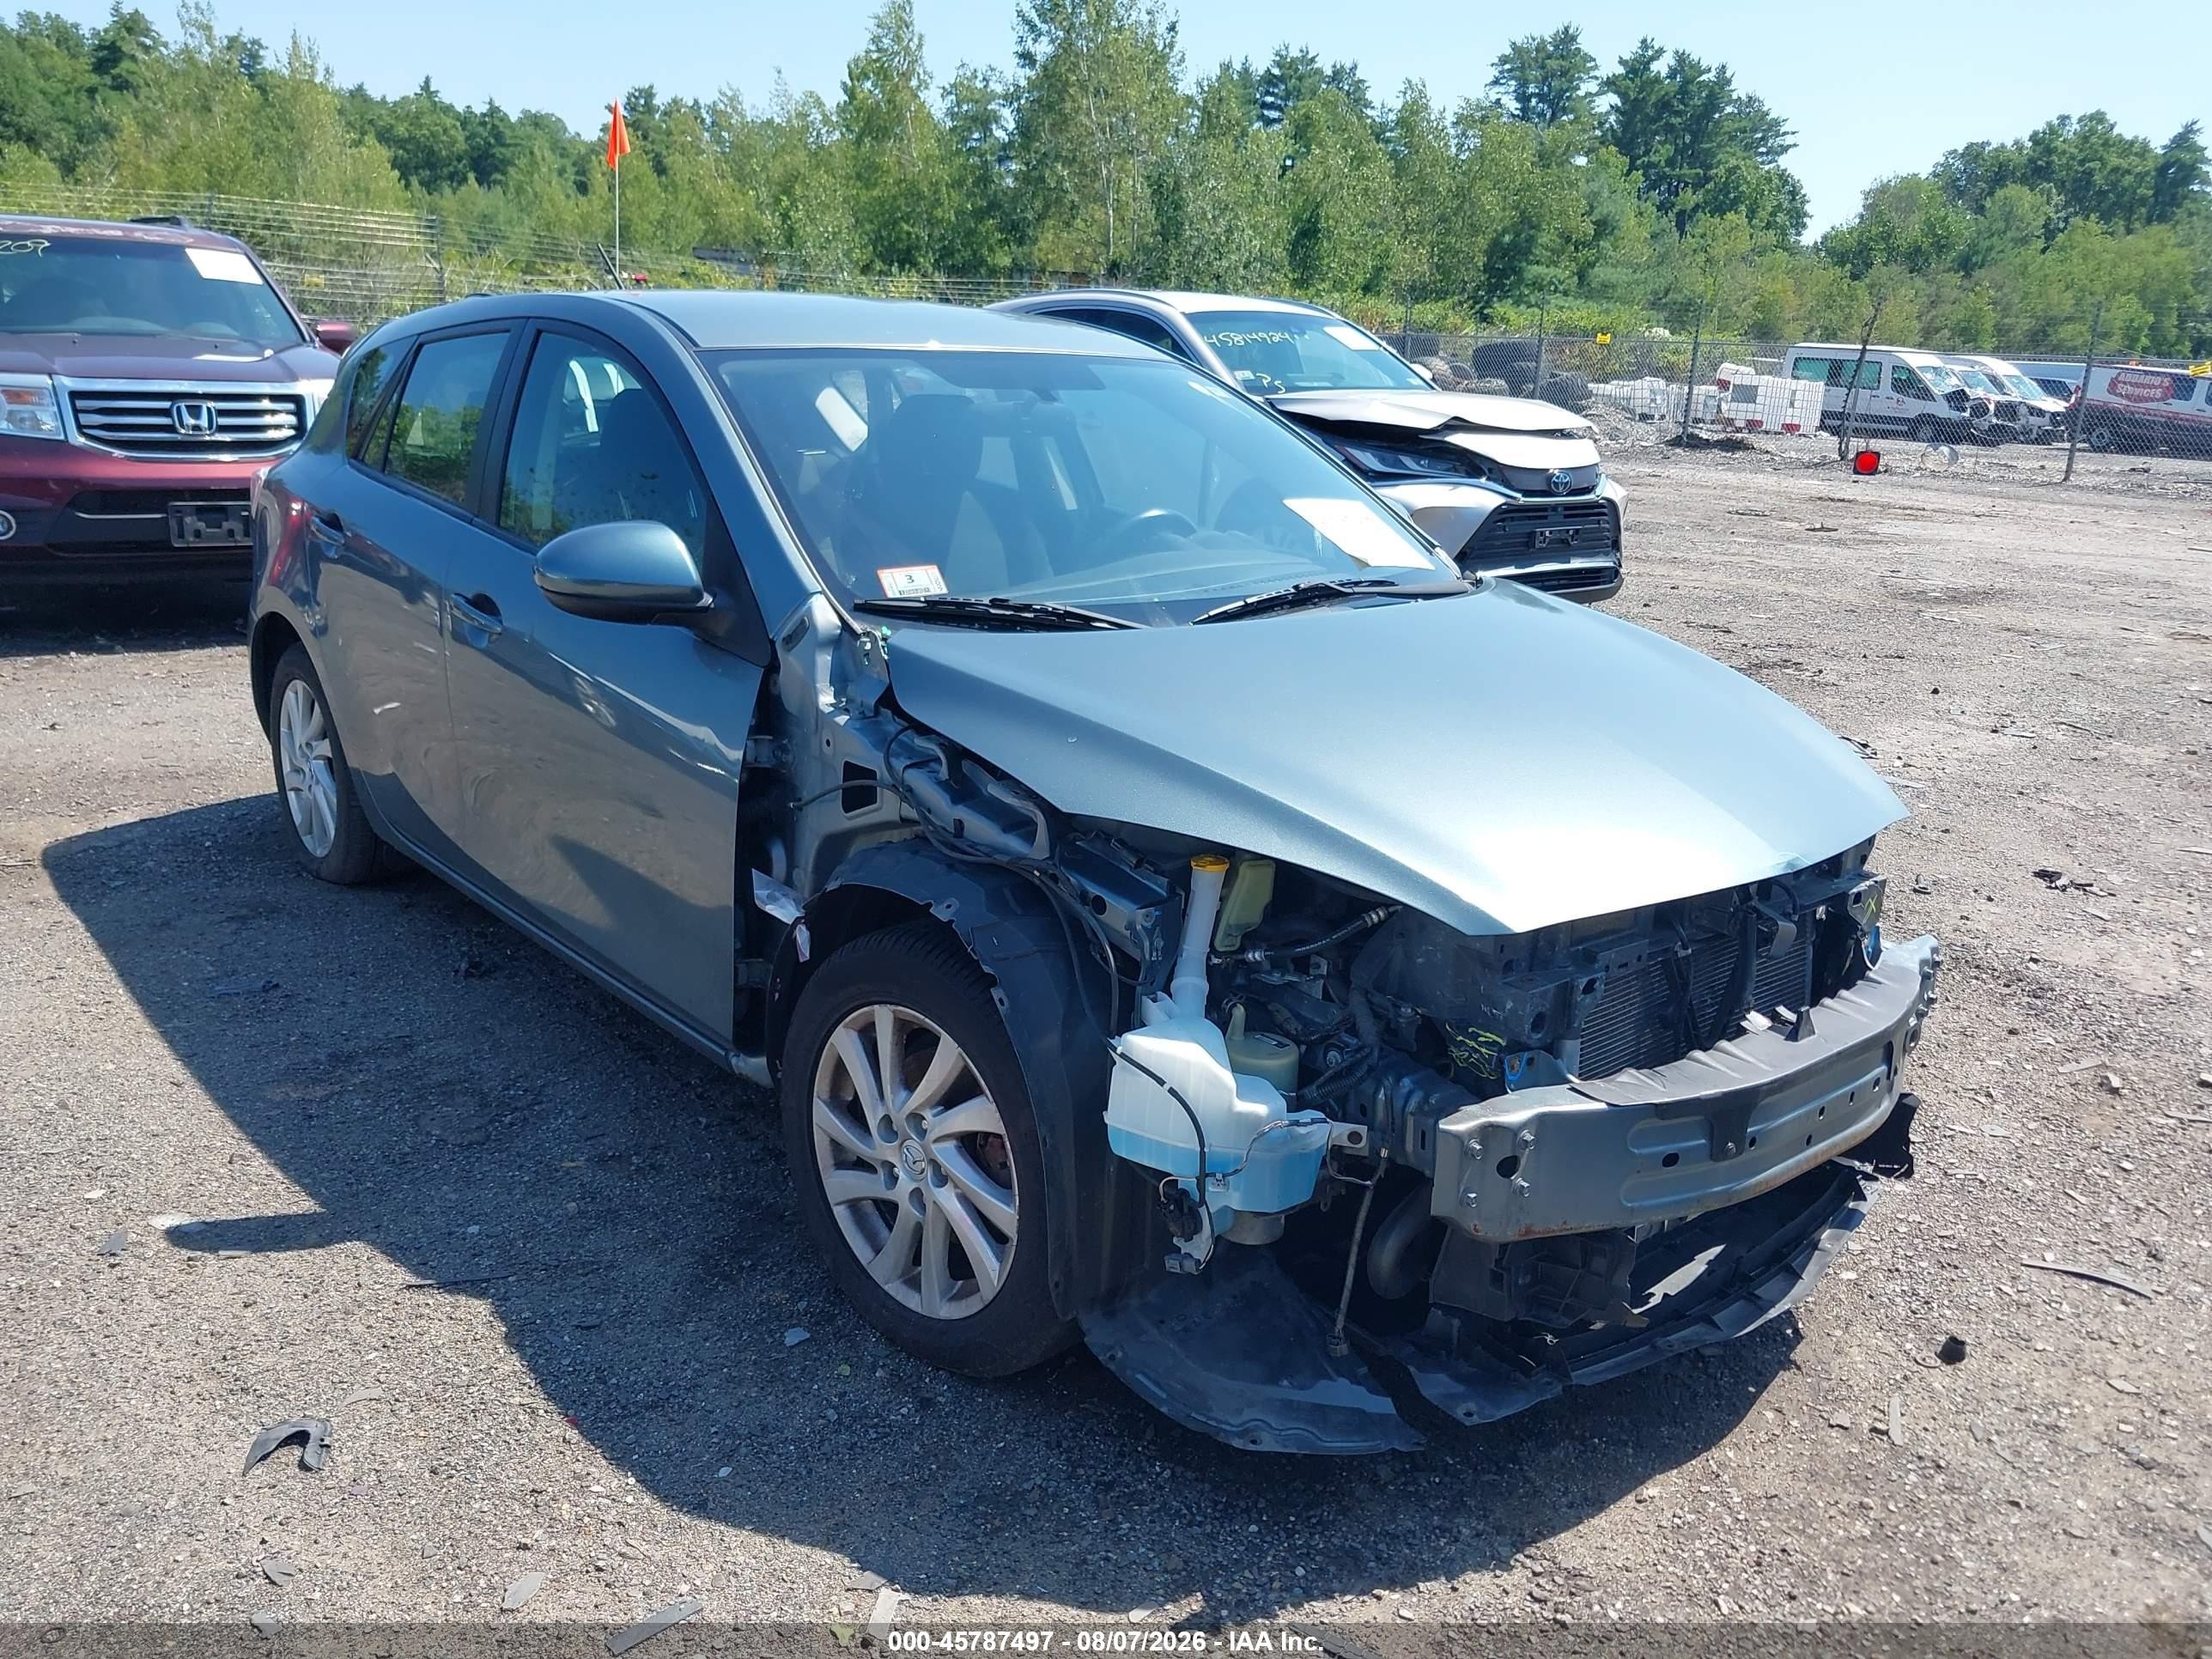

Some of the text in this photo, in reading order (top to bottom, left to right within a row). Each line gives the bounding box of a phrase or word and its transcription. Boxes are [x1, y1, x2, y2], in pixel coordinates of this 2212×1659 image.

[1204, 331, 1295, 348] 45814924
[2116, 383, 2163, 398] SERVICES
[904, 574, 915, 584] 3
